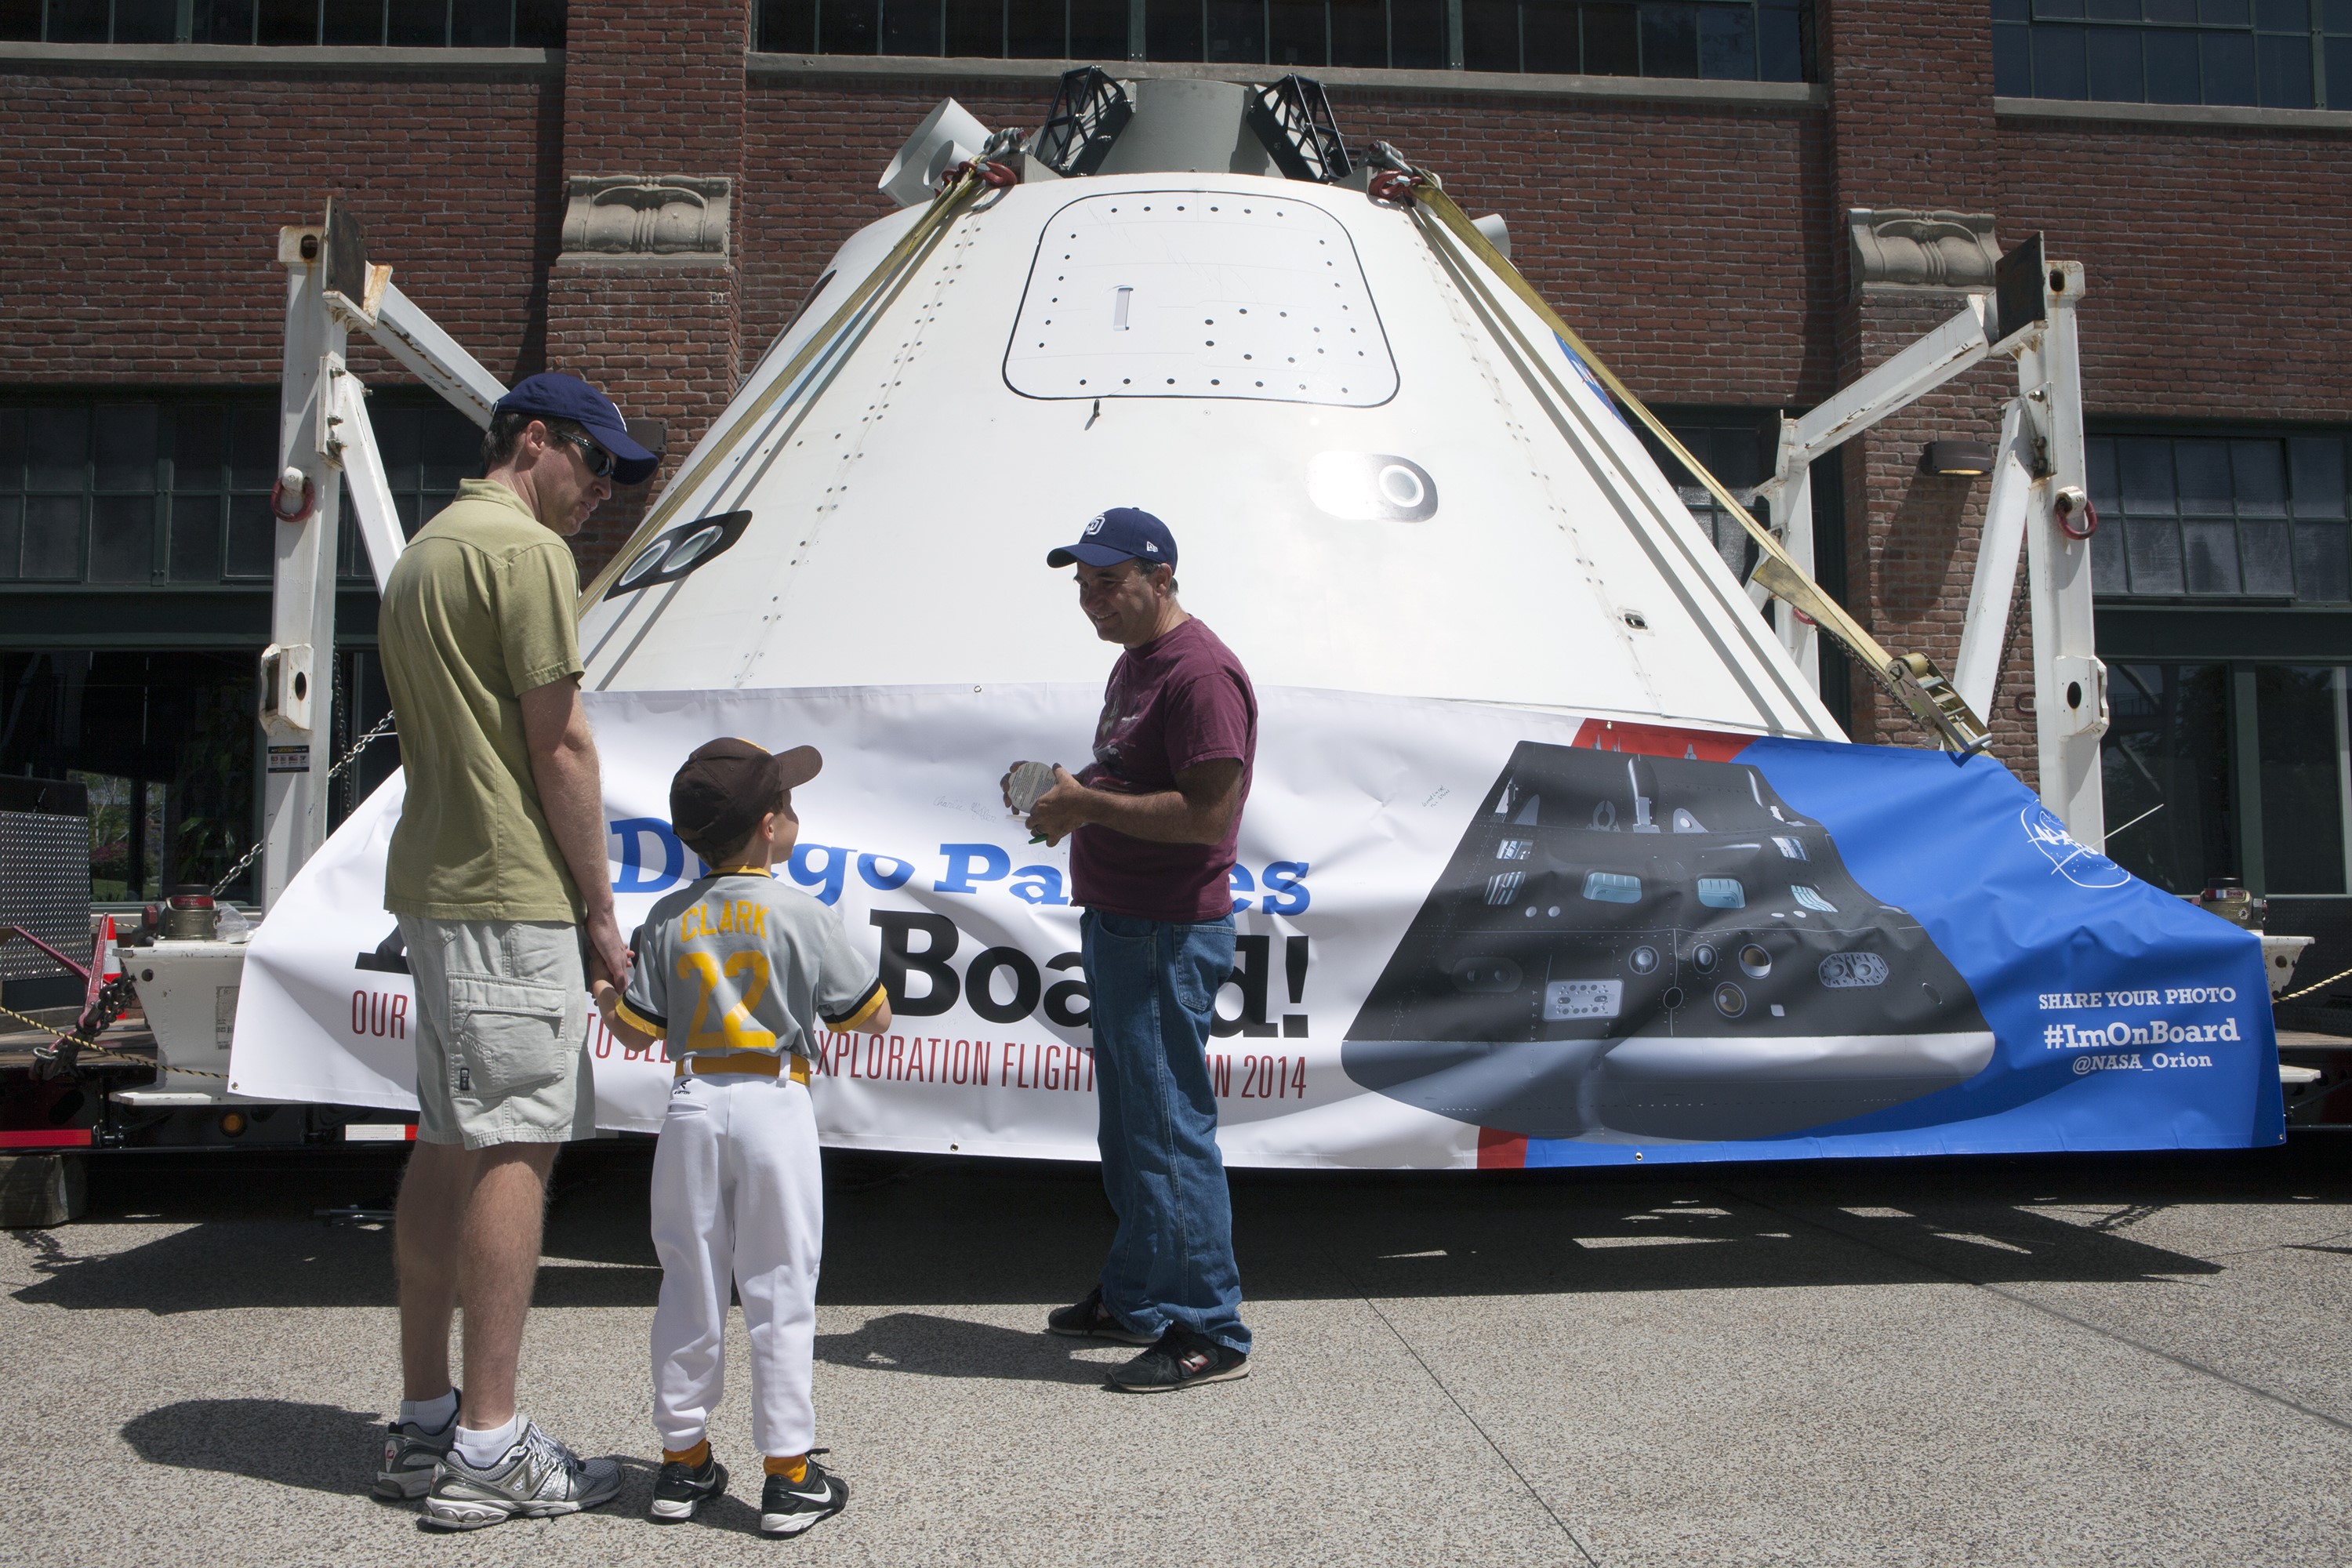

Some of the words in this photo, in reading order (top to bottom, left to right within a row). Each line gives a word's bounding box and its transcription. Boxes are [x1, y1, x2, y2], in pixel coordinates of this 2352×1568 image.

[612, 817, 915, 906] Dgo
[933, 843, 1311, 916] Paes
[681, 900, 771, 942] CLARK
[869, 909, 1309, 1037] Boad!
[352, 989, 408, 1040] OUR
[677, 950, 776, 1049] 22
[2039, 993, 2102, 1010] SHARE
[2106, 990, 2161, 1007] YOUR
[2165, 987, 2237, 1005] PHOTO
[2043, 1018, 2241, 1050] #ImOnBoard
[810, 1029, 991, 1087] XPLORATION
[1001, 1042, 1094, 1092] FLIGHT
[1241, 1054, 1307, 1098] 2014
[2072, 1052, 2212, 1075] @NASA_Orion
